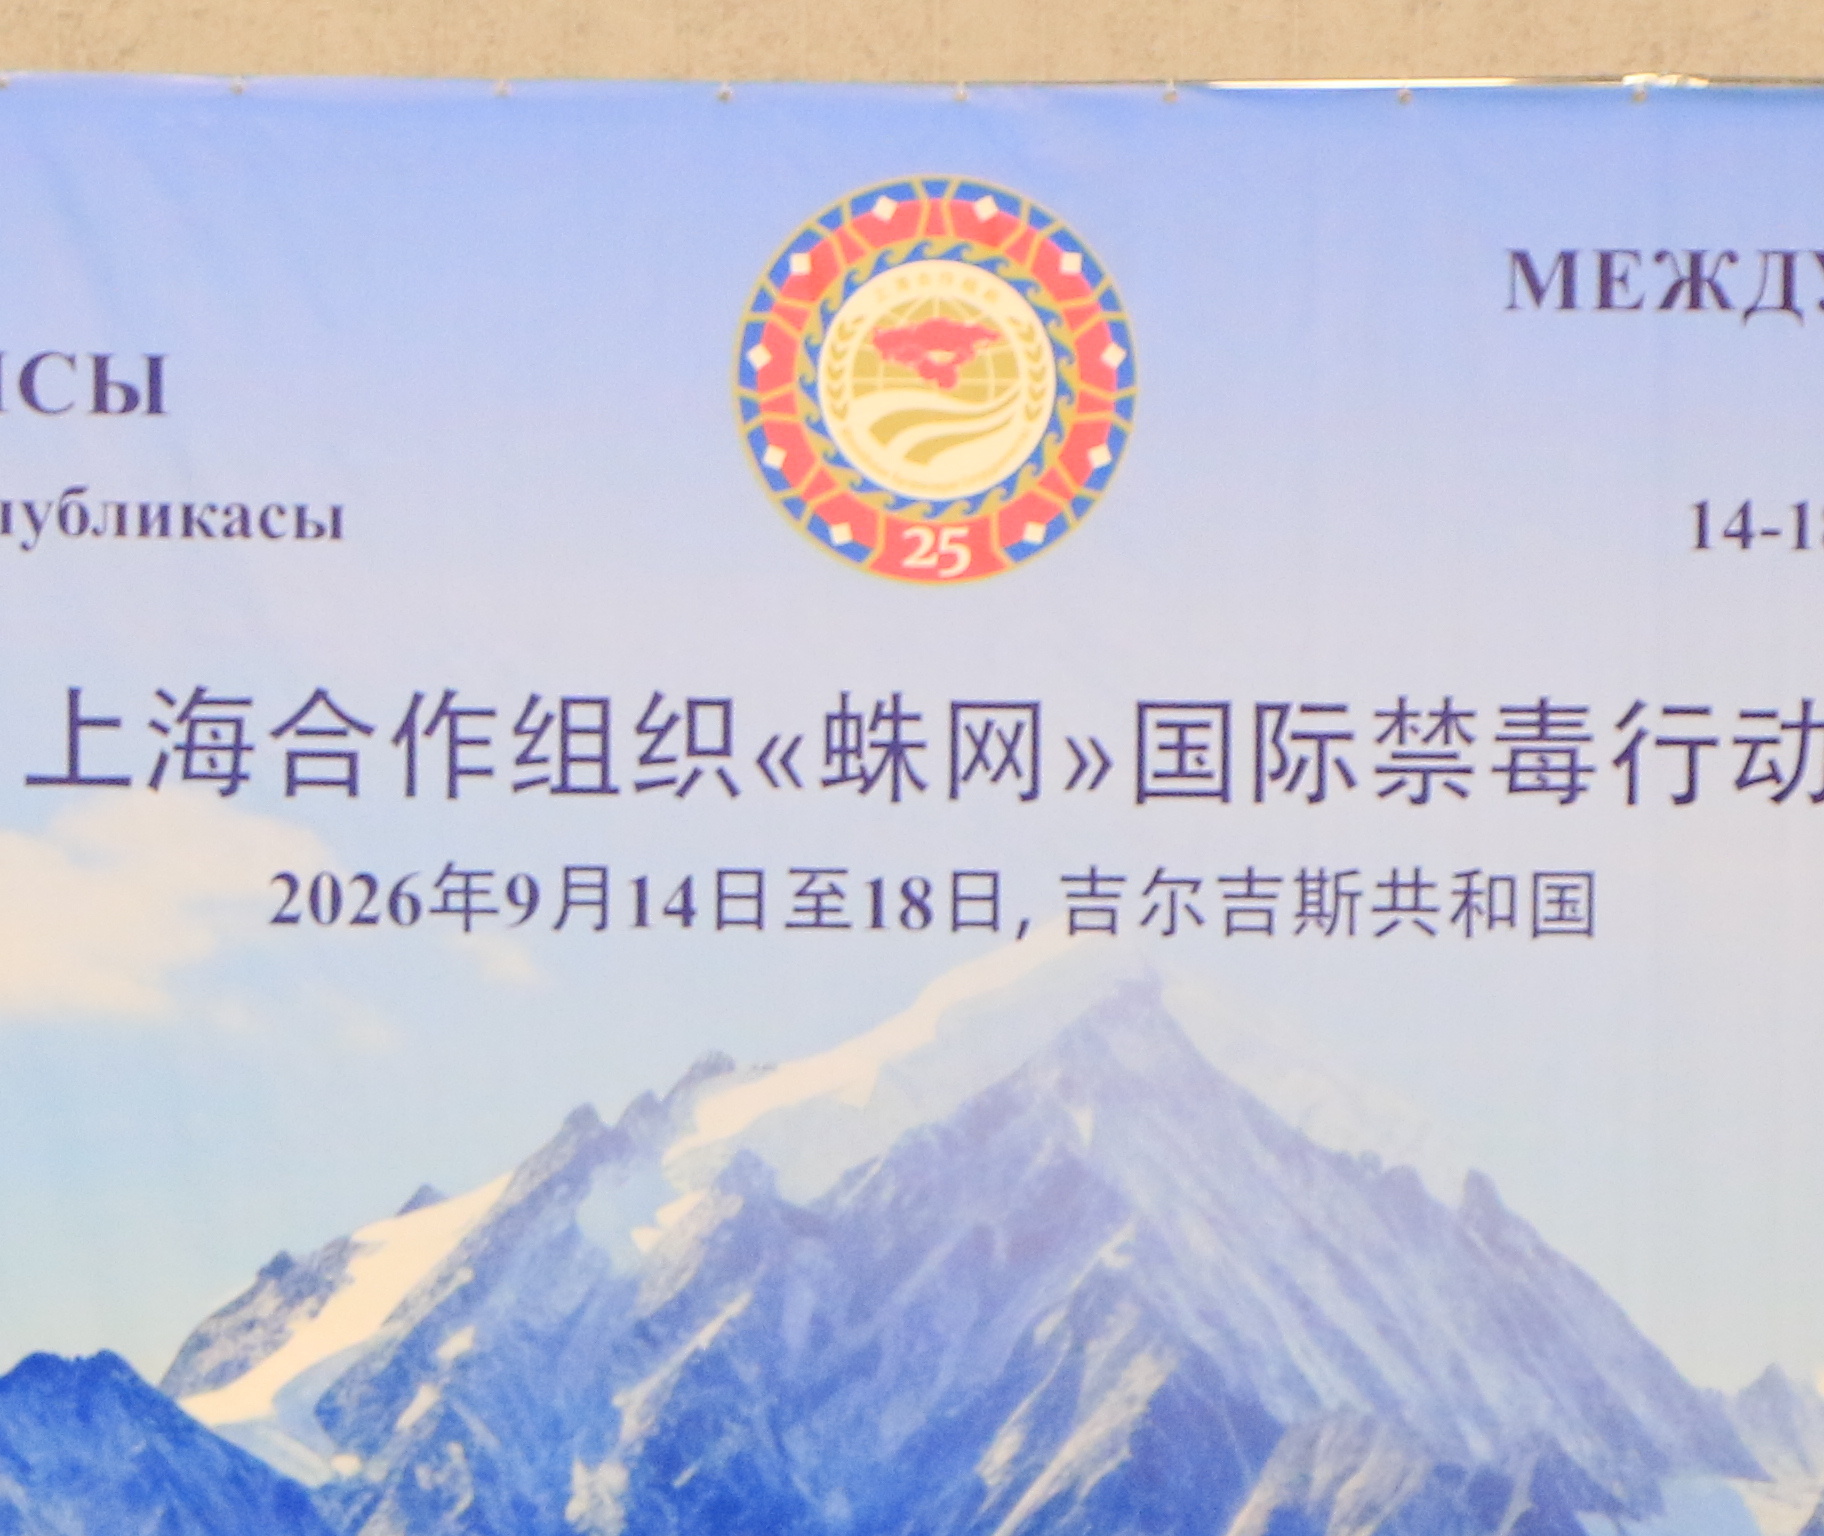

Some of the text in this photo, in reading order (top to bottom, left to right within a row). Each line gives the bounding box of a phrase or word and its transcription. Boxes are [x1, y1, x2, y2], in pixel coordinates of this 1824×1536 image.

[901, 525, 972, 578] 25
[1059, 863, 1597, 940] 吉尔吉斯共和国
